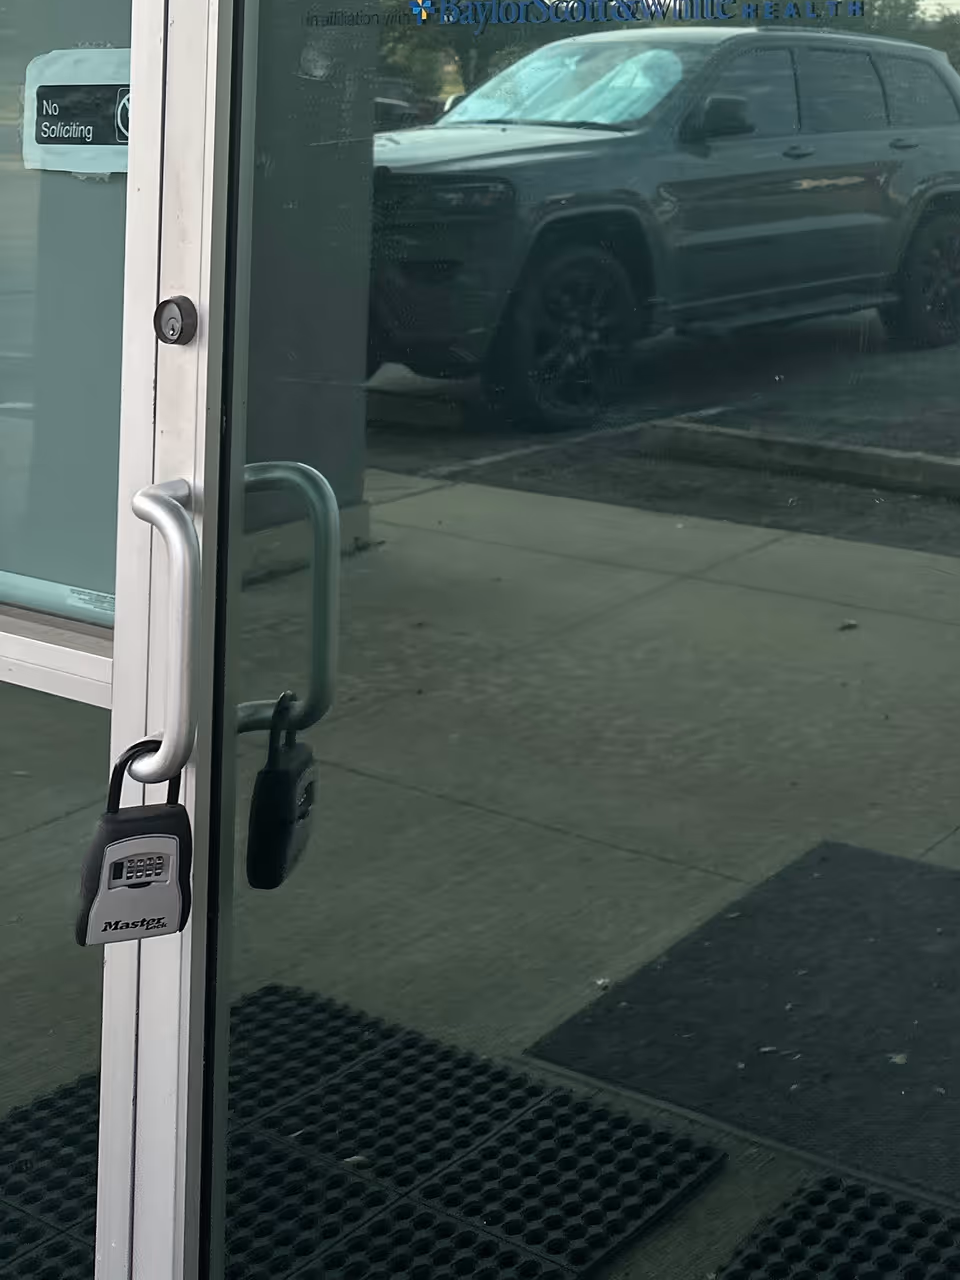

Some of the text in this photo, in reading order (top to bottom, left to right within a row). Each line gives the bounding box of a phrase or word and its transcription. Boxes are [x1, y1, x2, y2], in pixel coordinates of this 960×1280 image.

[742, 0, 865, 19] HEALTH
[42, 99, 59, 116] No
[40, 121, 93, 142] Soliciting
[101, 916, 166, 933] Master
[144, 922, 168, 931] Lock
